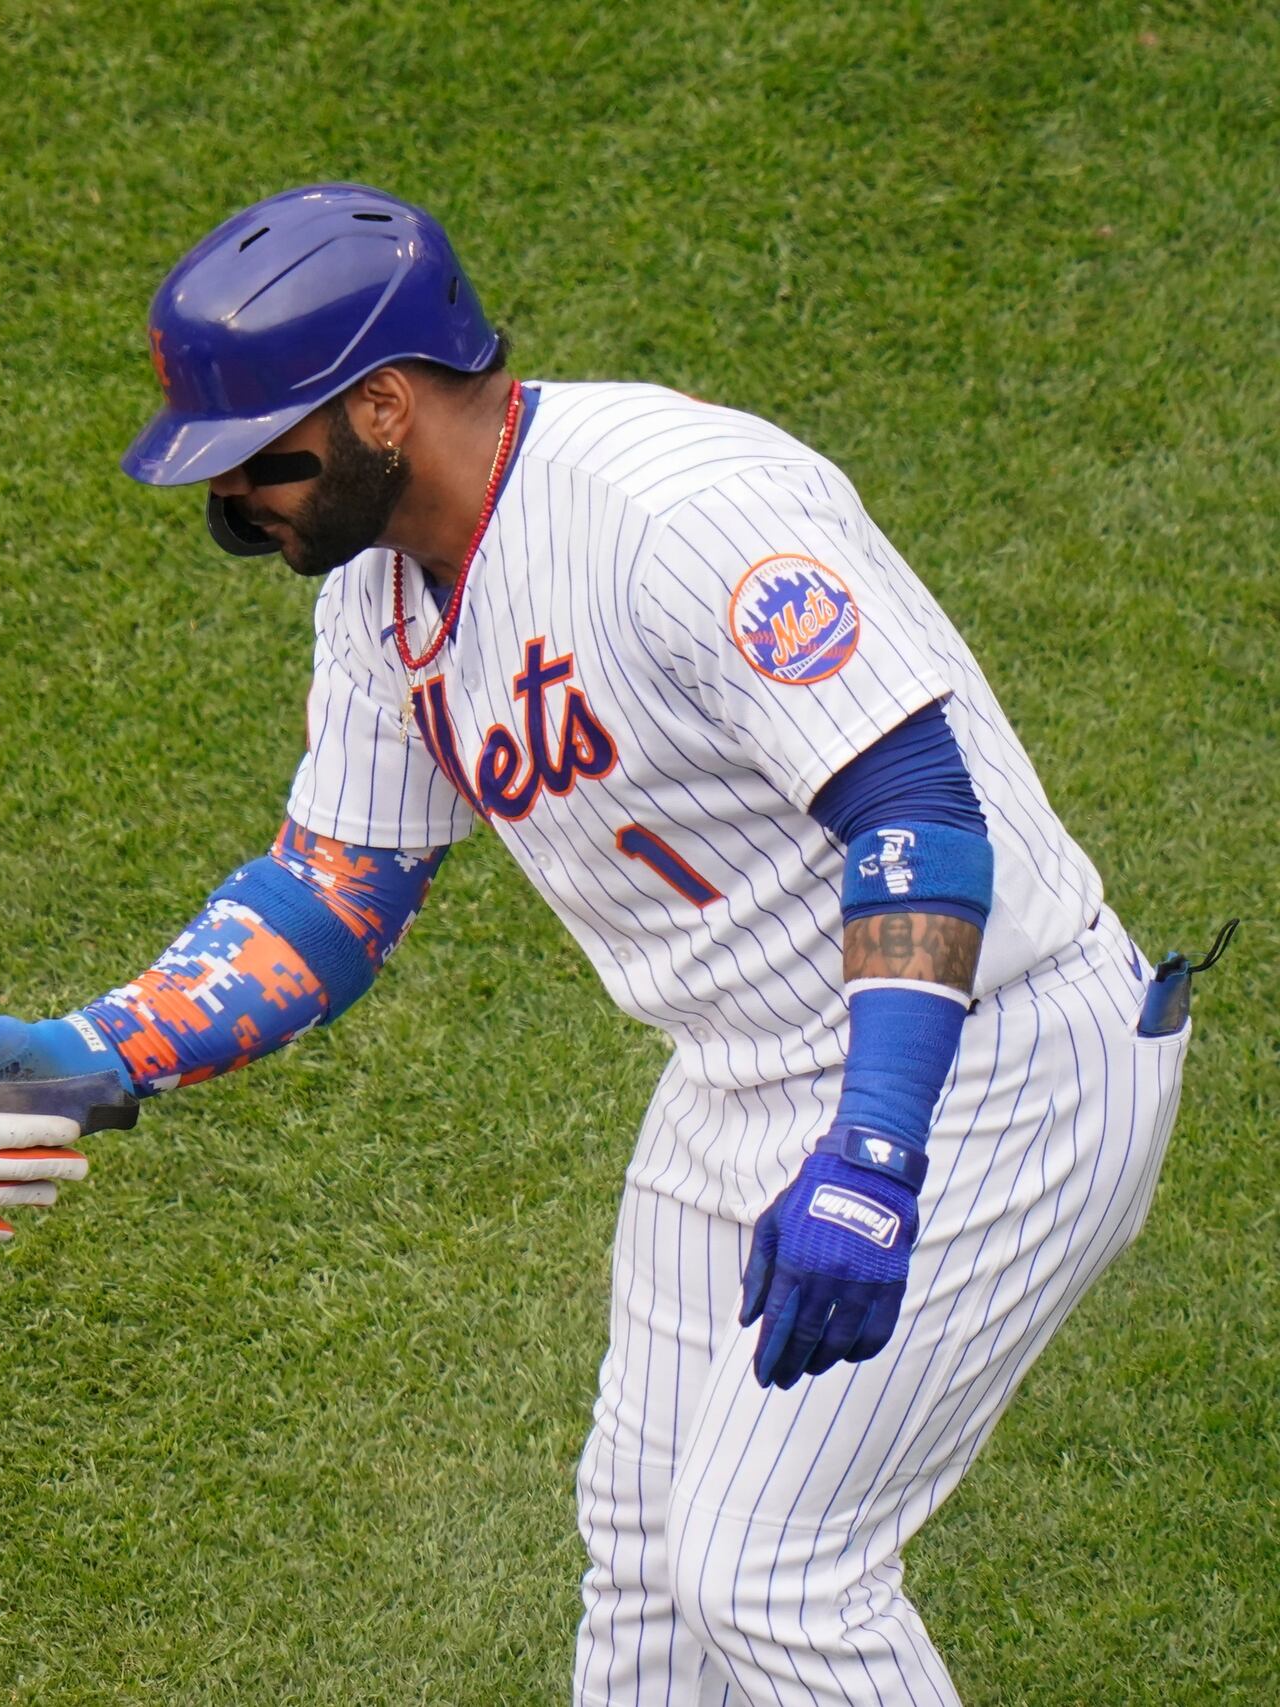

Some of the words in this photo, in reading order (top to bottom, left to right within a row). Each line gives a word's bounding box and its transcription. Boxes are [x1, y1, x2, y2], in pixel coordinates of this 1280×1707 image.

[770, 586, 839, 667] Mets
[616, 824, 722, 908] 1
[814, 1192, 896, 1240] Franklin
